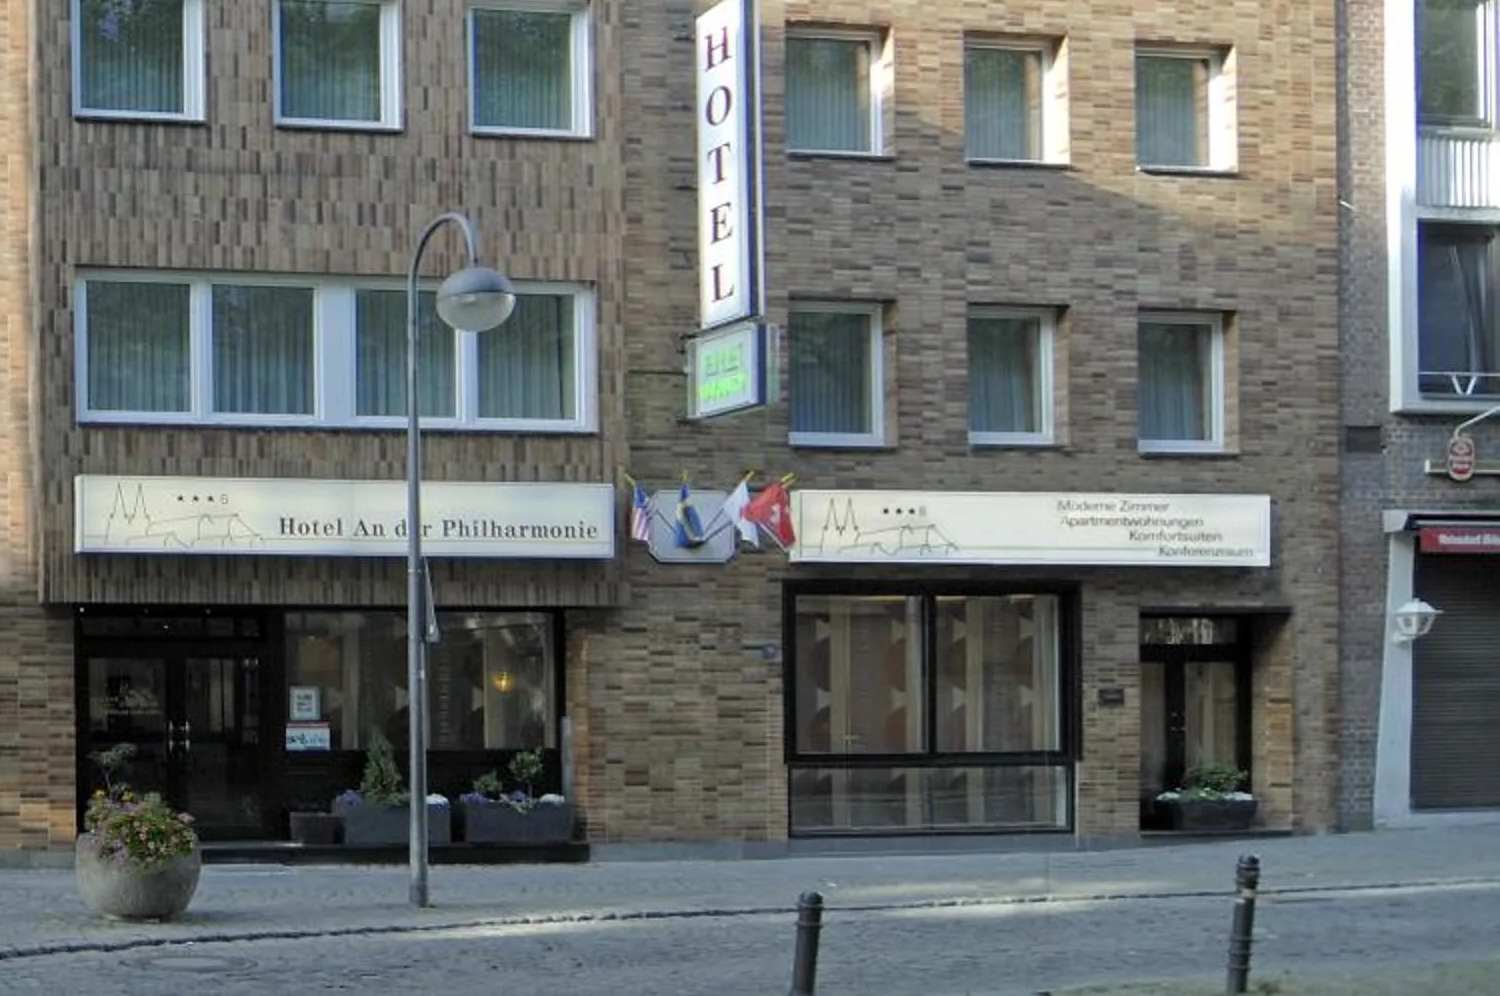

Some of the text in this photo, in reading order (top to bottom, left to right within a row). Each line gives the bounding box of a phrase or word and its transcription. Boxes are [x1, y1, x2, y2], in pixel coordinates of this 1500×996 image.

[704, 25, 735, 304] HOTEL
[1057, 499, 1170, 512] Moderne Zimmer
[279, 517, 598, 539] Hotel An dr Philharmonie
[1061, 515, 1205, 529] Apartmentwohnungen
[1129, 530, 1224, 543] Komfortsuiten
